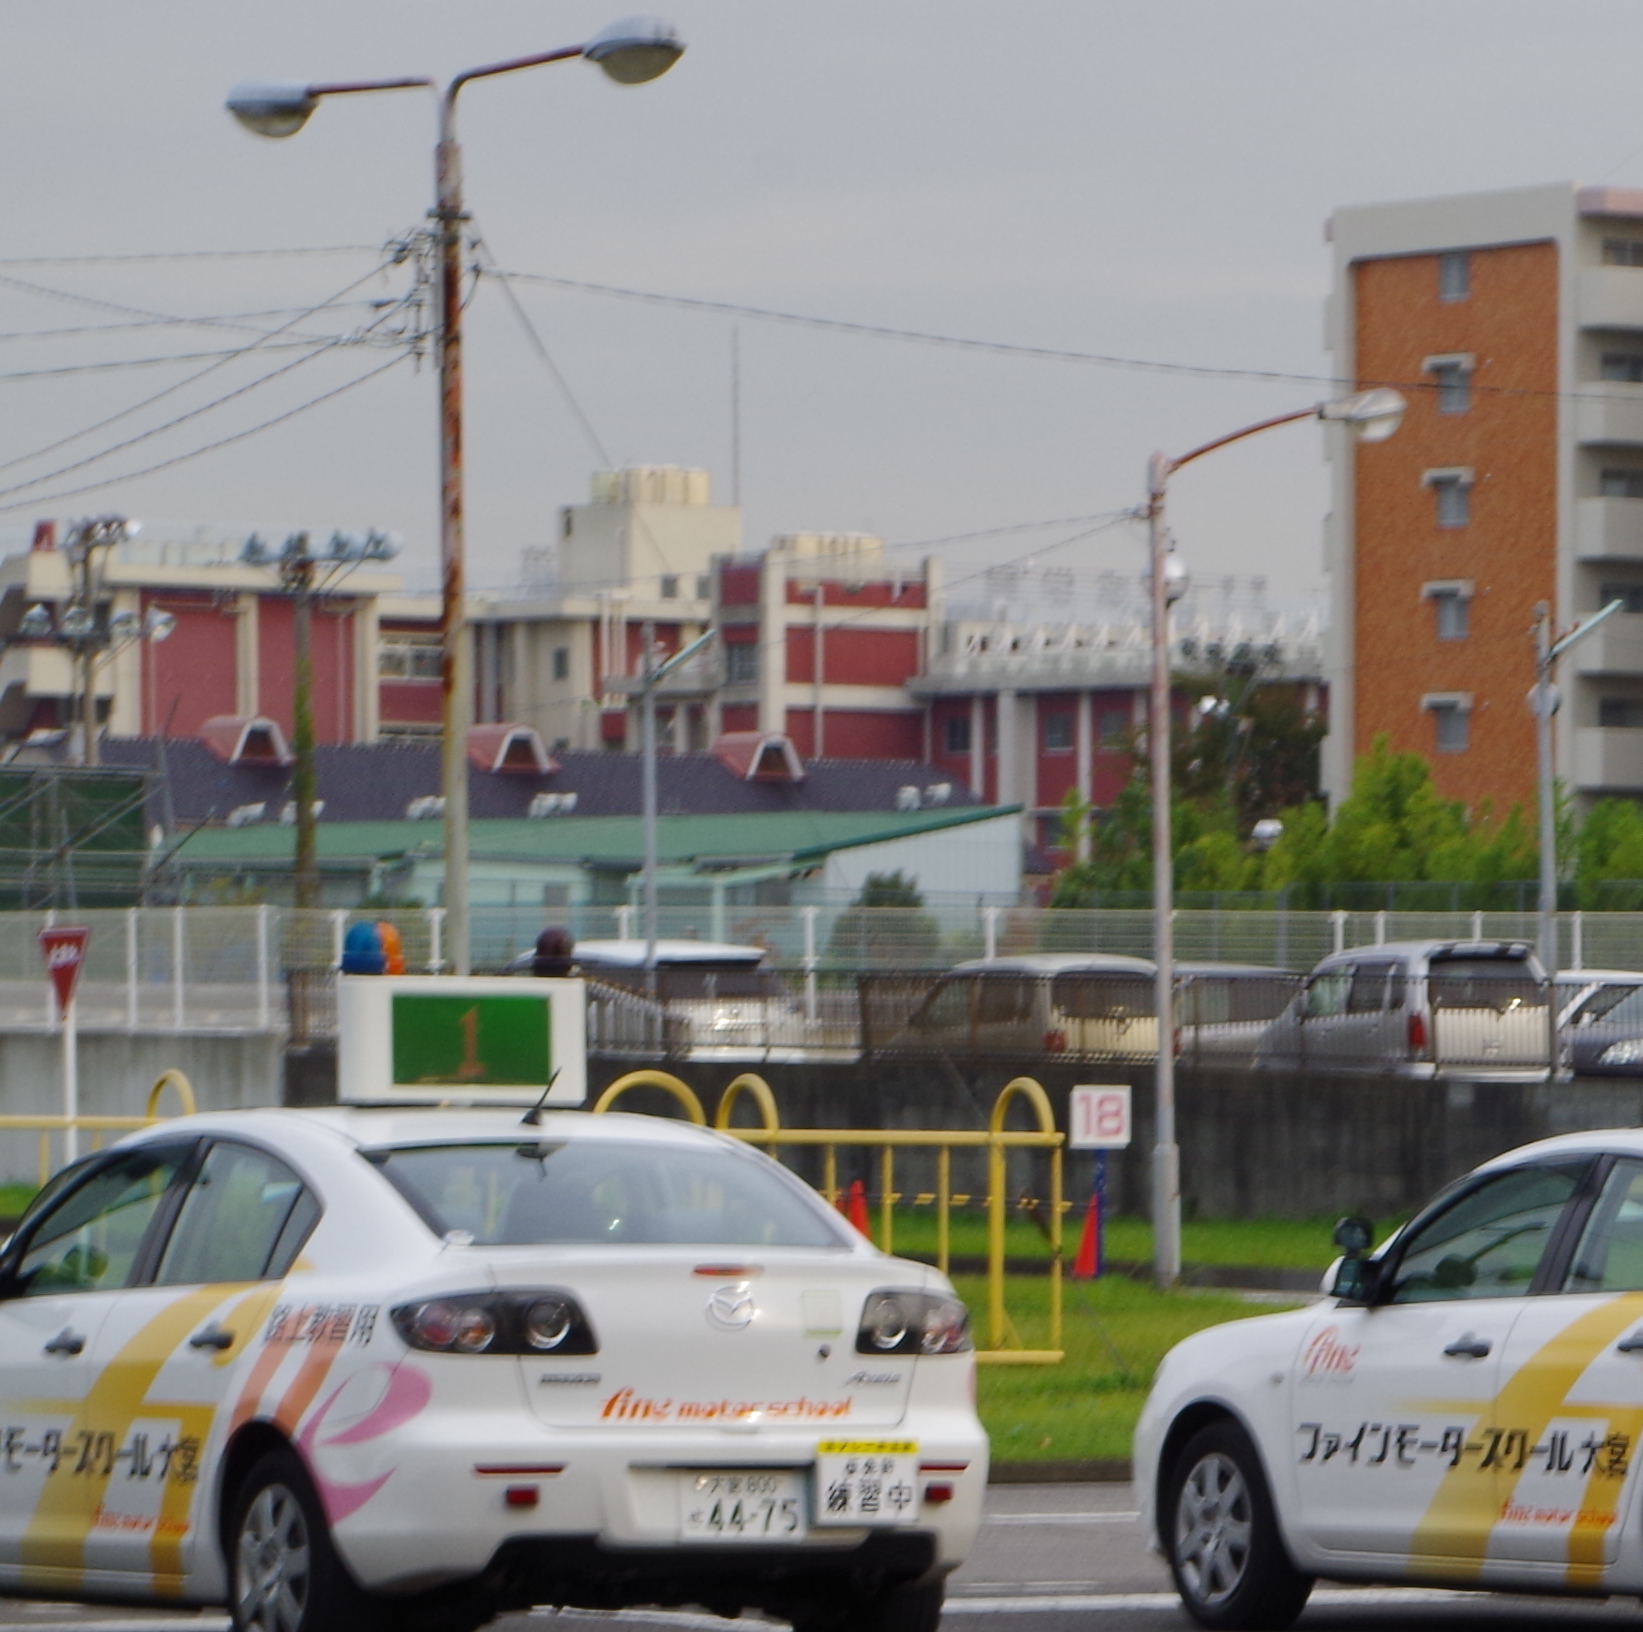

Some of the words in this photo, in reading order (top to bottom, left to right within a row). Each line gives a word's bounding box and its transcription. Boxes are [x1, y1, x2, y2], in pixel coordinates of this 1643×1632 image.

[460, 1006, 486, 1077] 1
[1080, 1093, 1124, 1137] 18
[600, 1386, 672, 1421] fine
[677, 1399, 764, 1418] motor
[767, 1396, 853, 1417] school
[1298, 1422, 1630, 1476] ファインモータースクール大宮
[709, 1498, 798, 1533] 44-75
